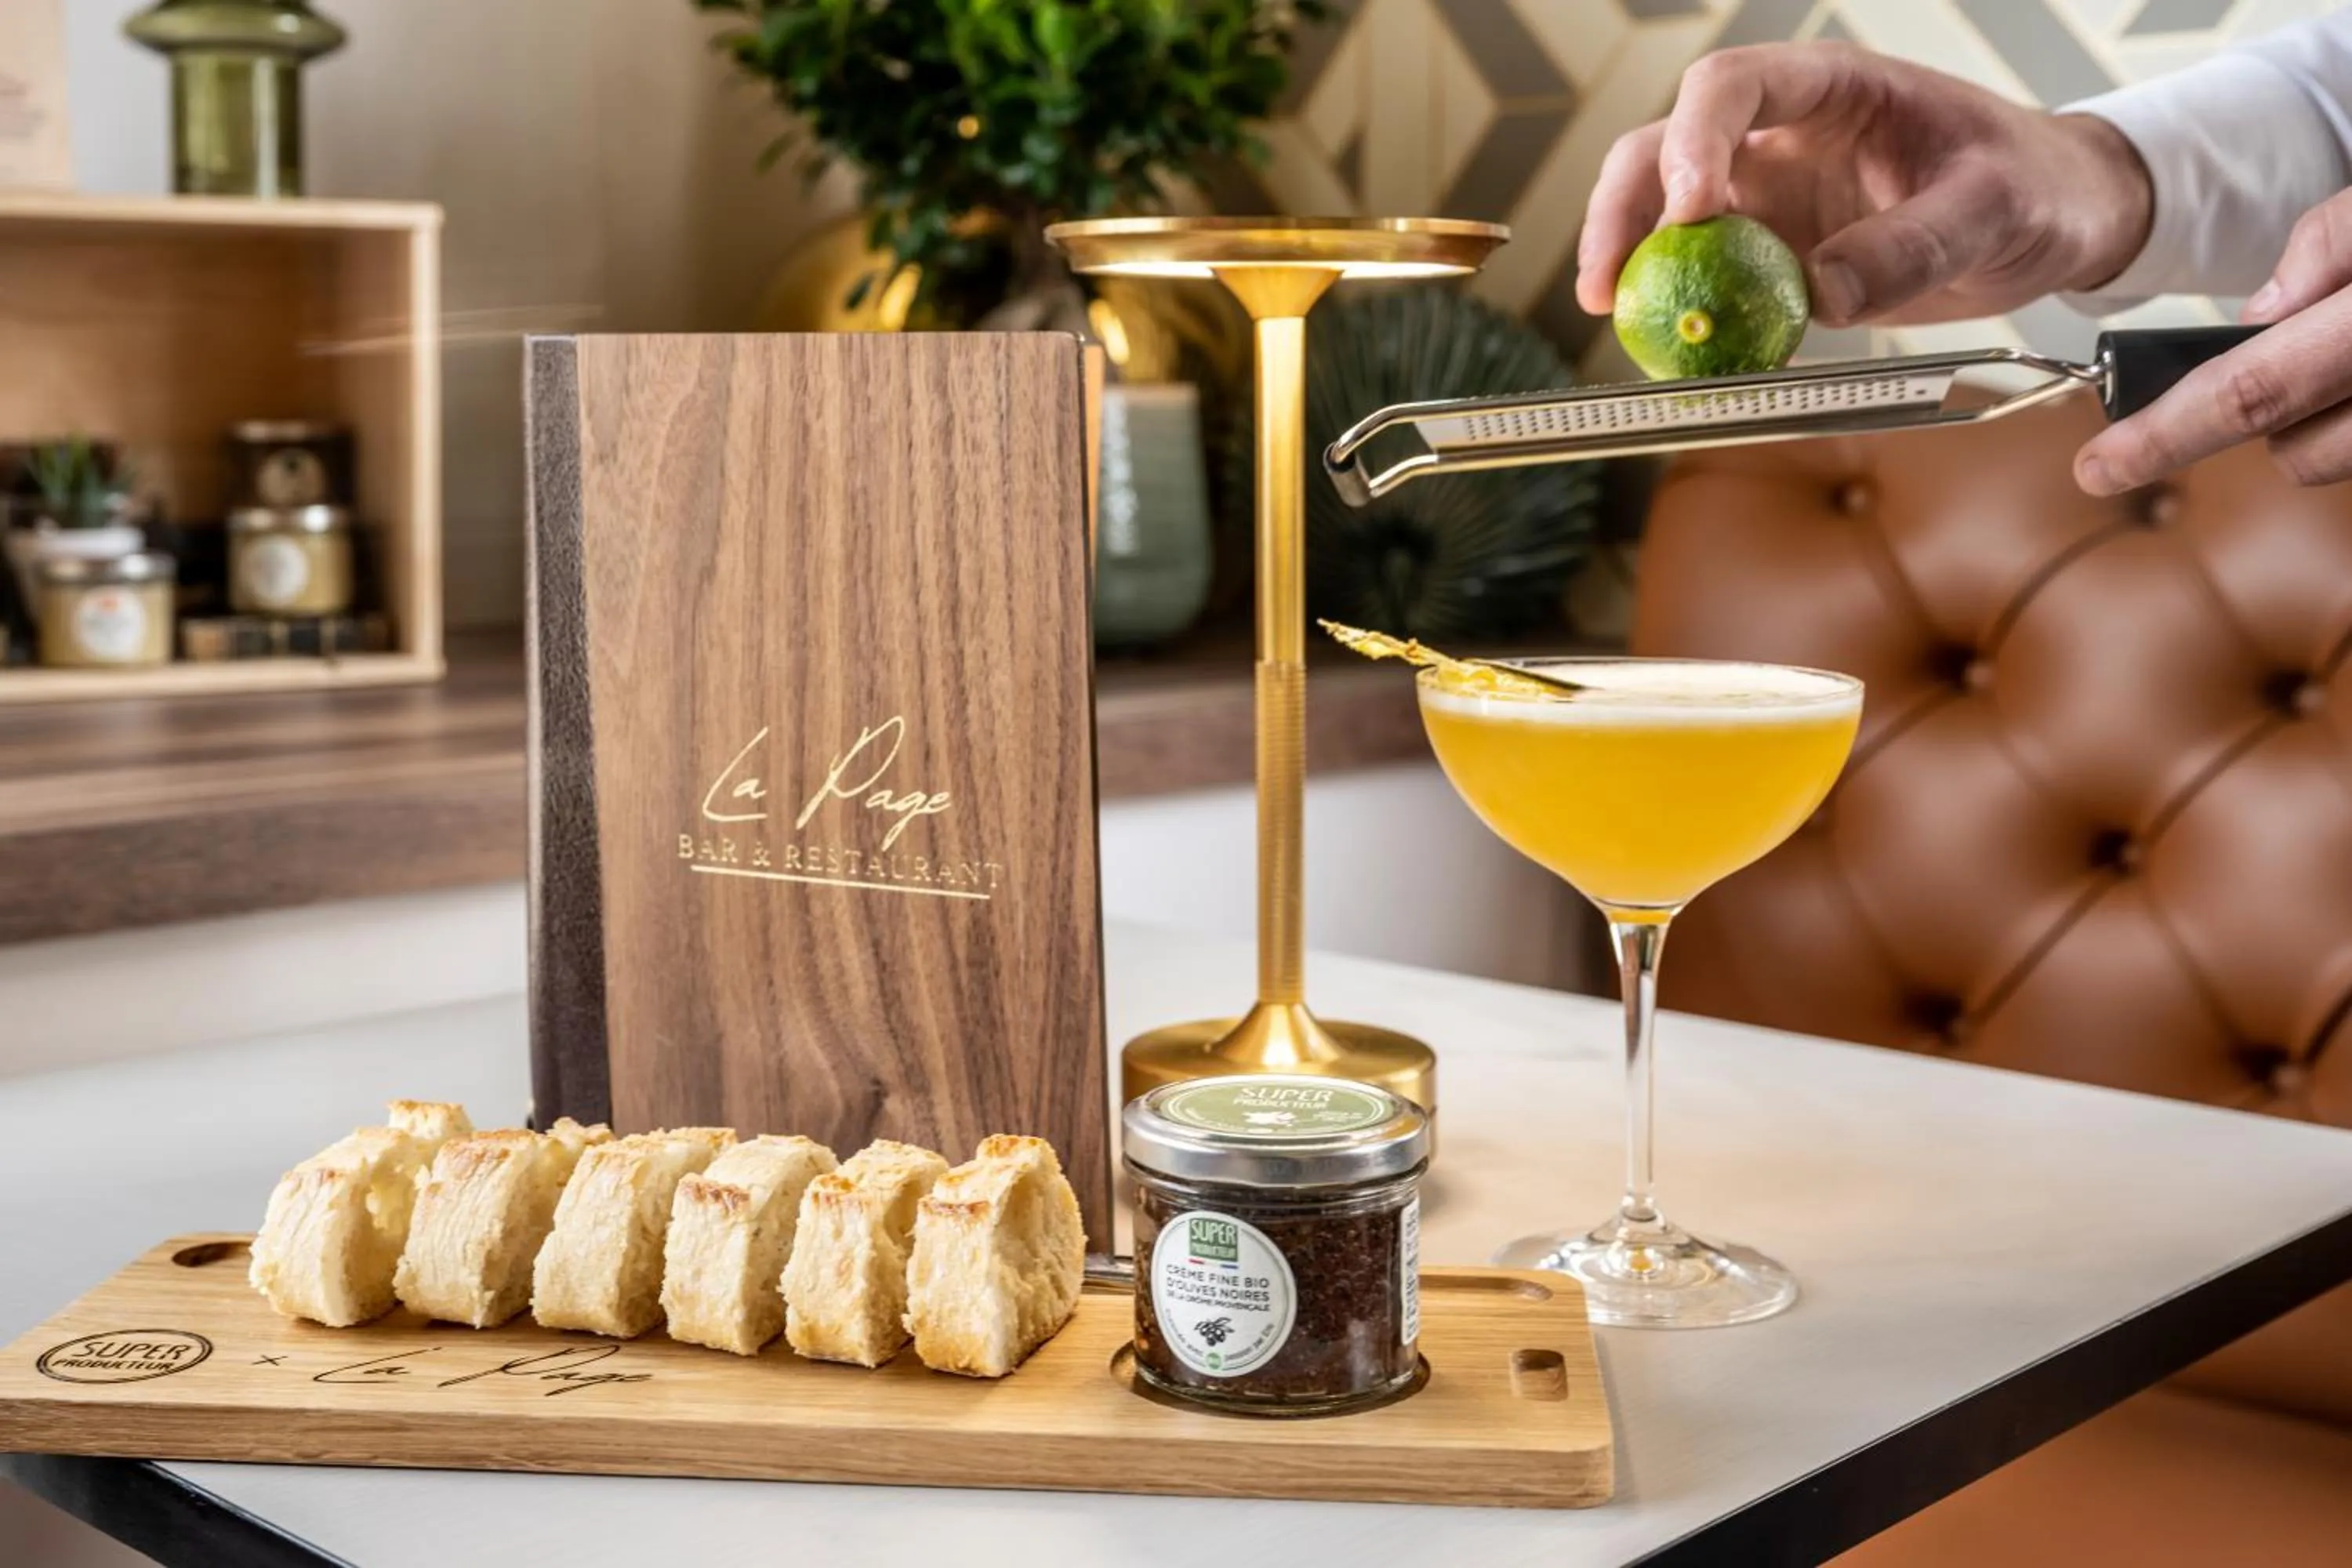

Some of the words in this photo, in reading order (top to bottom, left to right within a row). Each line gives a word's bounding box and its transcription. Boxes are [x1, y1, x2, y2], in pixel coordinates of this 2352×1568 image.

[704, 726, 768, 822] La
[795, 715, 953, 852] Page
[677, 834, 739, 864] BAR
[752, 841, 772, 867] &
[785, 844, 1004, 889] RESTAURANT
[1241, 1087, 1333, 1102] SUPER
[1191, 1219, 1236, 1245] SUPER
[1208, 1272, 1240, 1287] FINE
[1244, 1277, 1270, 1288] BIO
[1219, 1289, 1270, 1302] NOIRES
[72, 1341, 191, 1360] SUPER
[51, 1358, 175, 1370] PRODUCTEUR
[313, 1346, 442, 1383] La
[437, 1345, 653, 1397] Page
